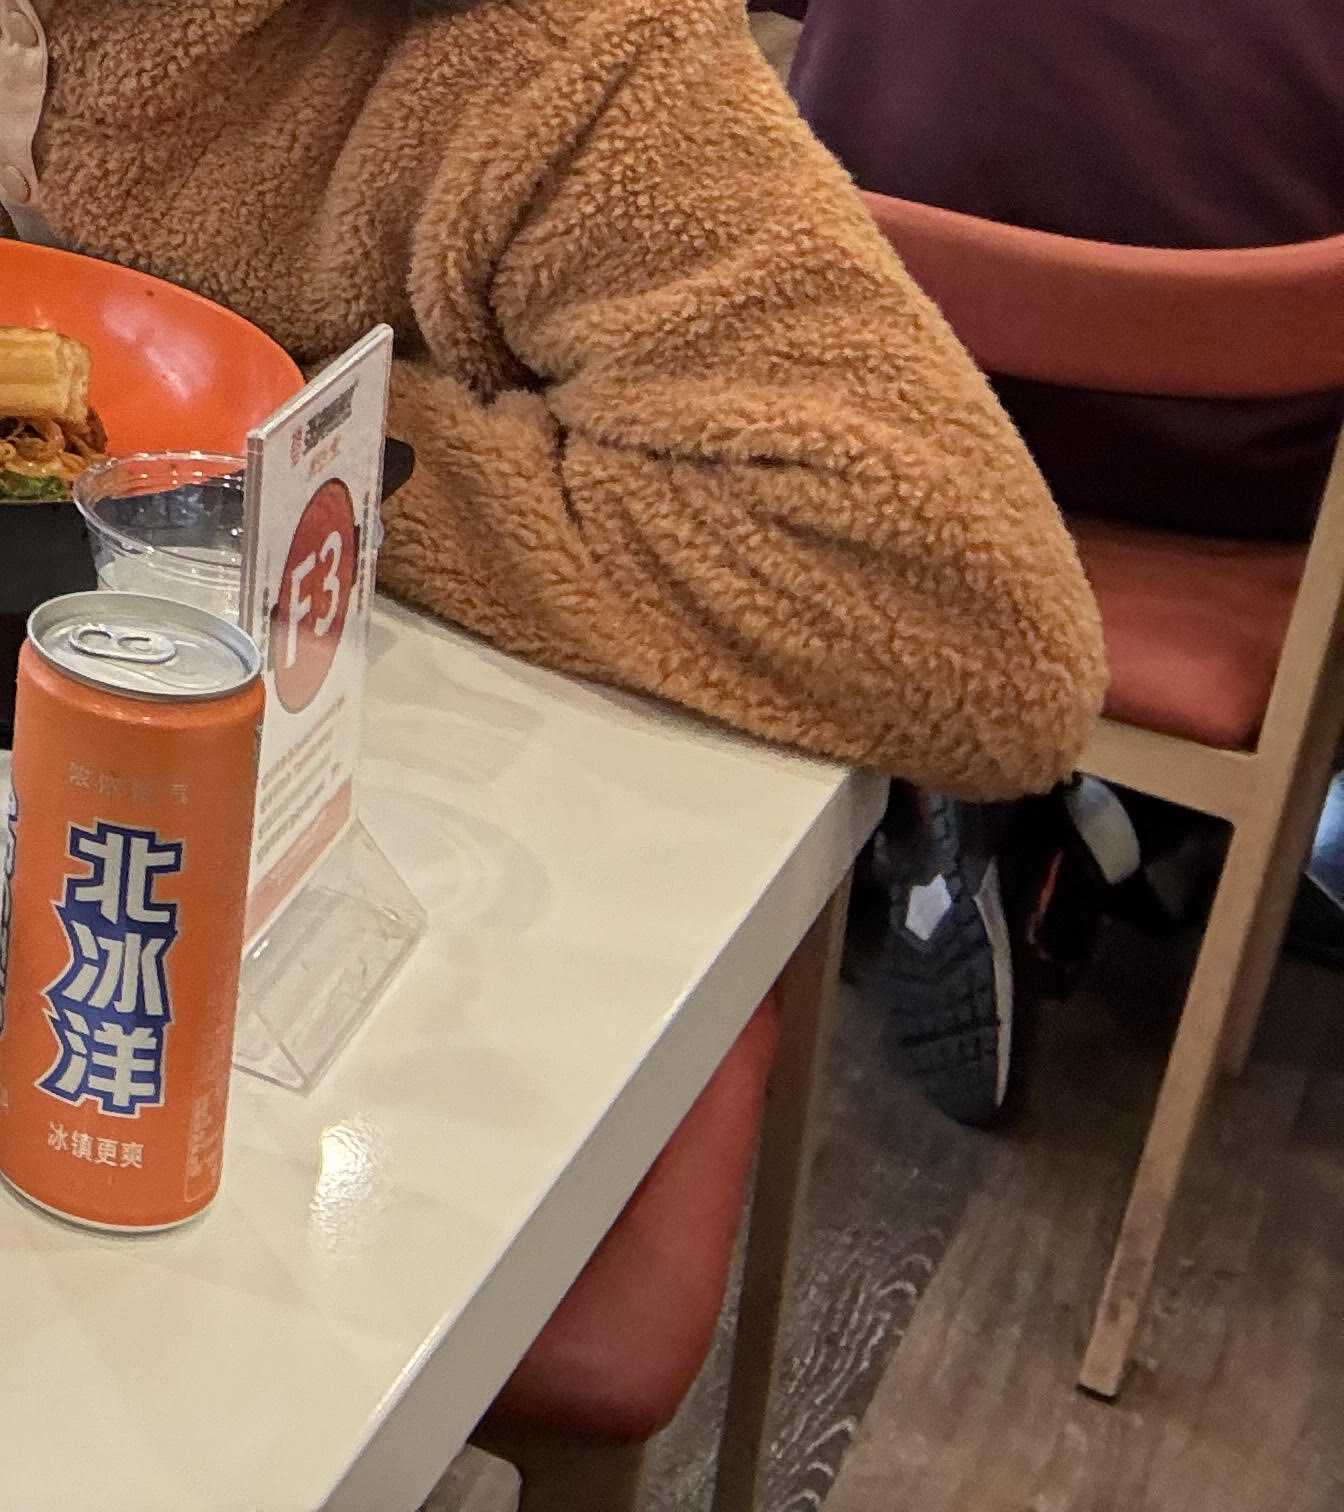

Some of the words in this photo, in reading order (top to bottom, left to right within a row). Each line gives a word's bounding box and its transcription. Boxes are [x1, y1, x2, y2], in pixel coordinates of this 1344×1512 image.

[285, 530, 343, 670] F3
[50, 826, 178, 1112] 北冰洋
[46, 1121, 145, 1169] 冰镇更爽
